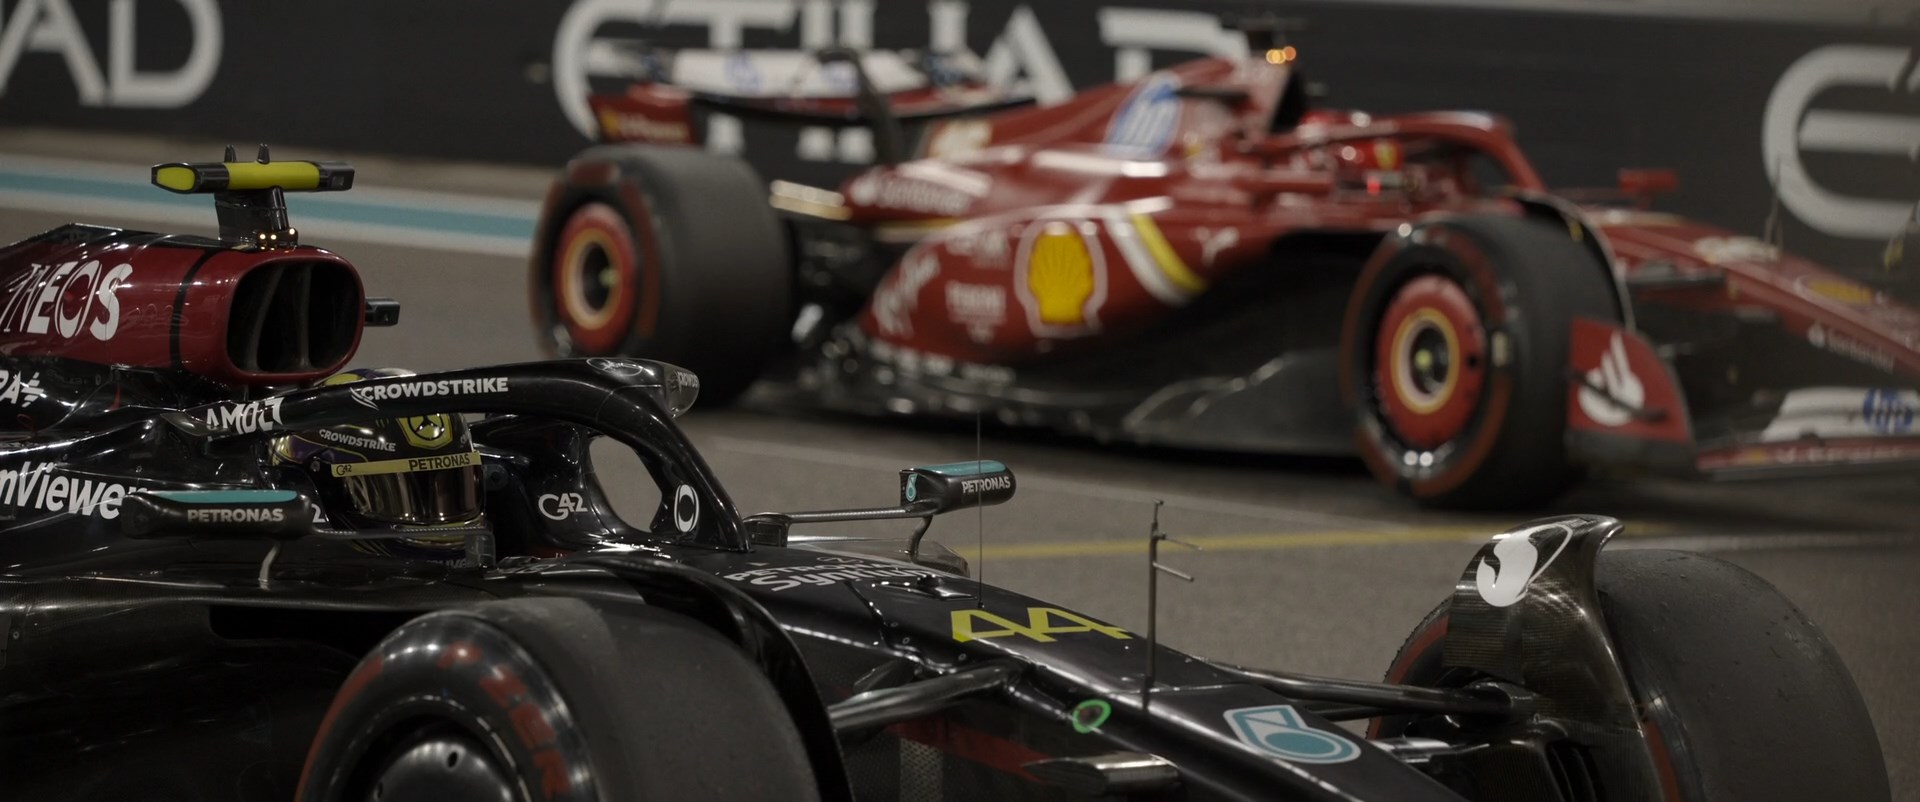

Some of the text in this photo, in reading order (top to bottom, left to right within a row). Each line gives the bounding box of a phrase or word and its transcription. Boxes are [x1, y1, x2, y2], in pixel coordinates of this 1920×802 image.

[353, 377, 508, 401] CROWDSTRIKE
[319, 428, 397, 453] CROWDSTRIKE
[408, 453, 471, 472] PETRONAS
[961, 476, 1011, 494] PETRONAS
[186, 508, 285, 523] PETRONAS
[950, 607, 1134, 644] 44
